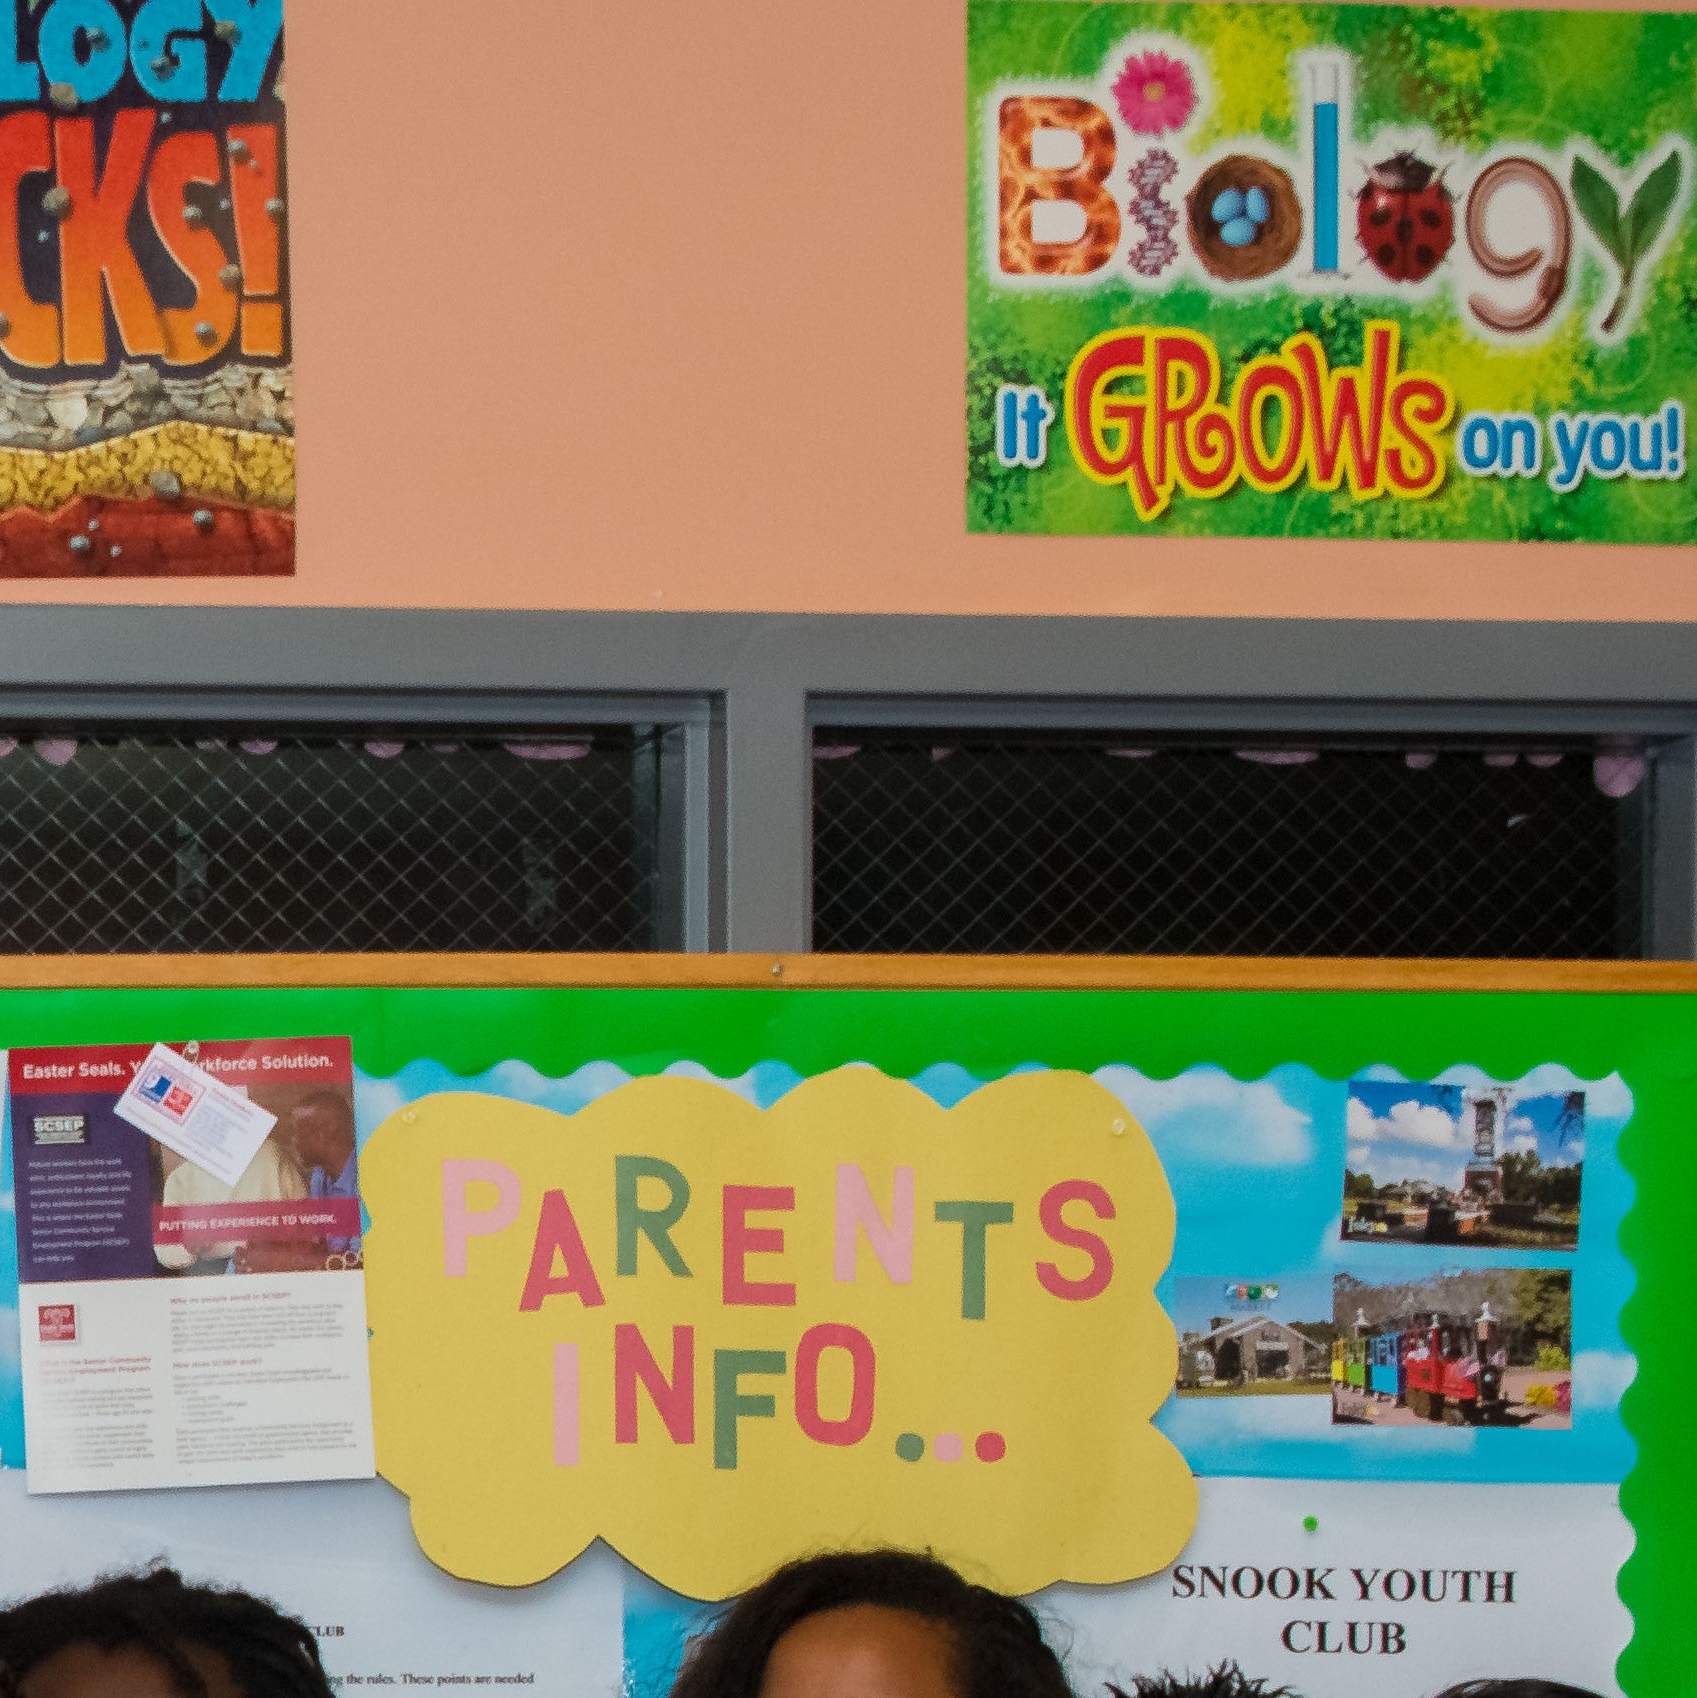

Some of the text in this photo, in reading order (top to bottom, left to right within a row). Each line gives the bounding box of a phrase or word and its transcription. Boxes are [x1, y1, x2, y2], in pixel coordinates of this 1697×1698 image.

[1003, 391, 1047, 460] It
[1463, 416, 1536, 471] on
[1556, 406, 1680, 485] you!
[23, 1063, 73, 1079] Easter
[78, 1060, 125, 1077] Seals.
[261, 1053, 334, 1070] Solution.
[159, 1217, 206, 1232] PUTTING
[208, 1215, 278, 1230] EXPERIENCE
[280, 1214, 296, 1227] TO
[441, 1153, 1117, 1321] PARENTS
[553, 1322, 1006, 1470] INFO...
[1172, 1564, 1518, 1604] SNOOK YOUTH
[1280, 1618, 1407, 1656] CLUB
[346, 1672, 363, 1684] the
[366, 1673, 396, 1685] rules.
[400, 1672, 435, 1684] These
[436, 1673, 471, 1687] points
[474, 1675, 491, 1684] are
[494, 1672, 534, 1684] needed
